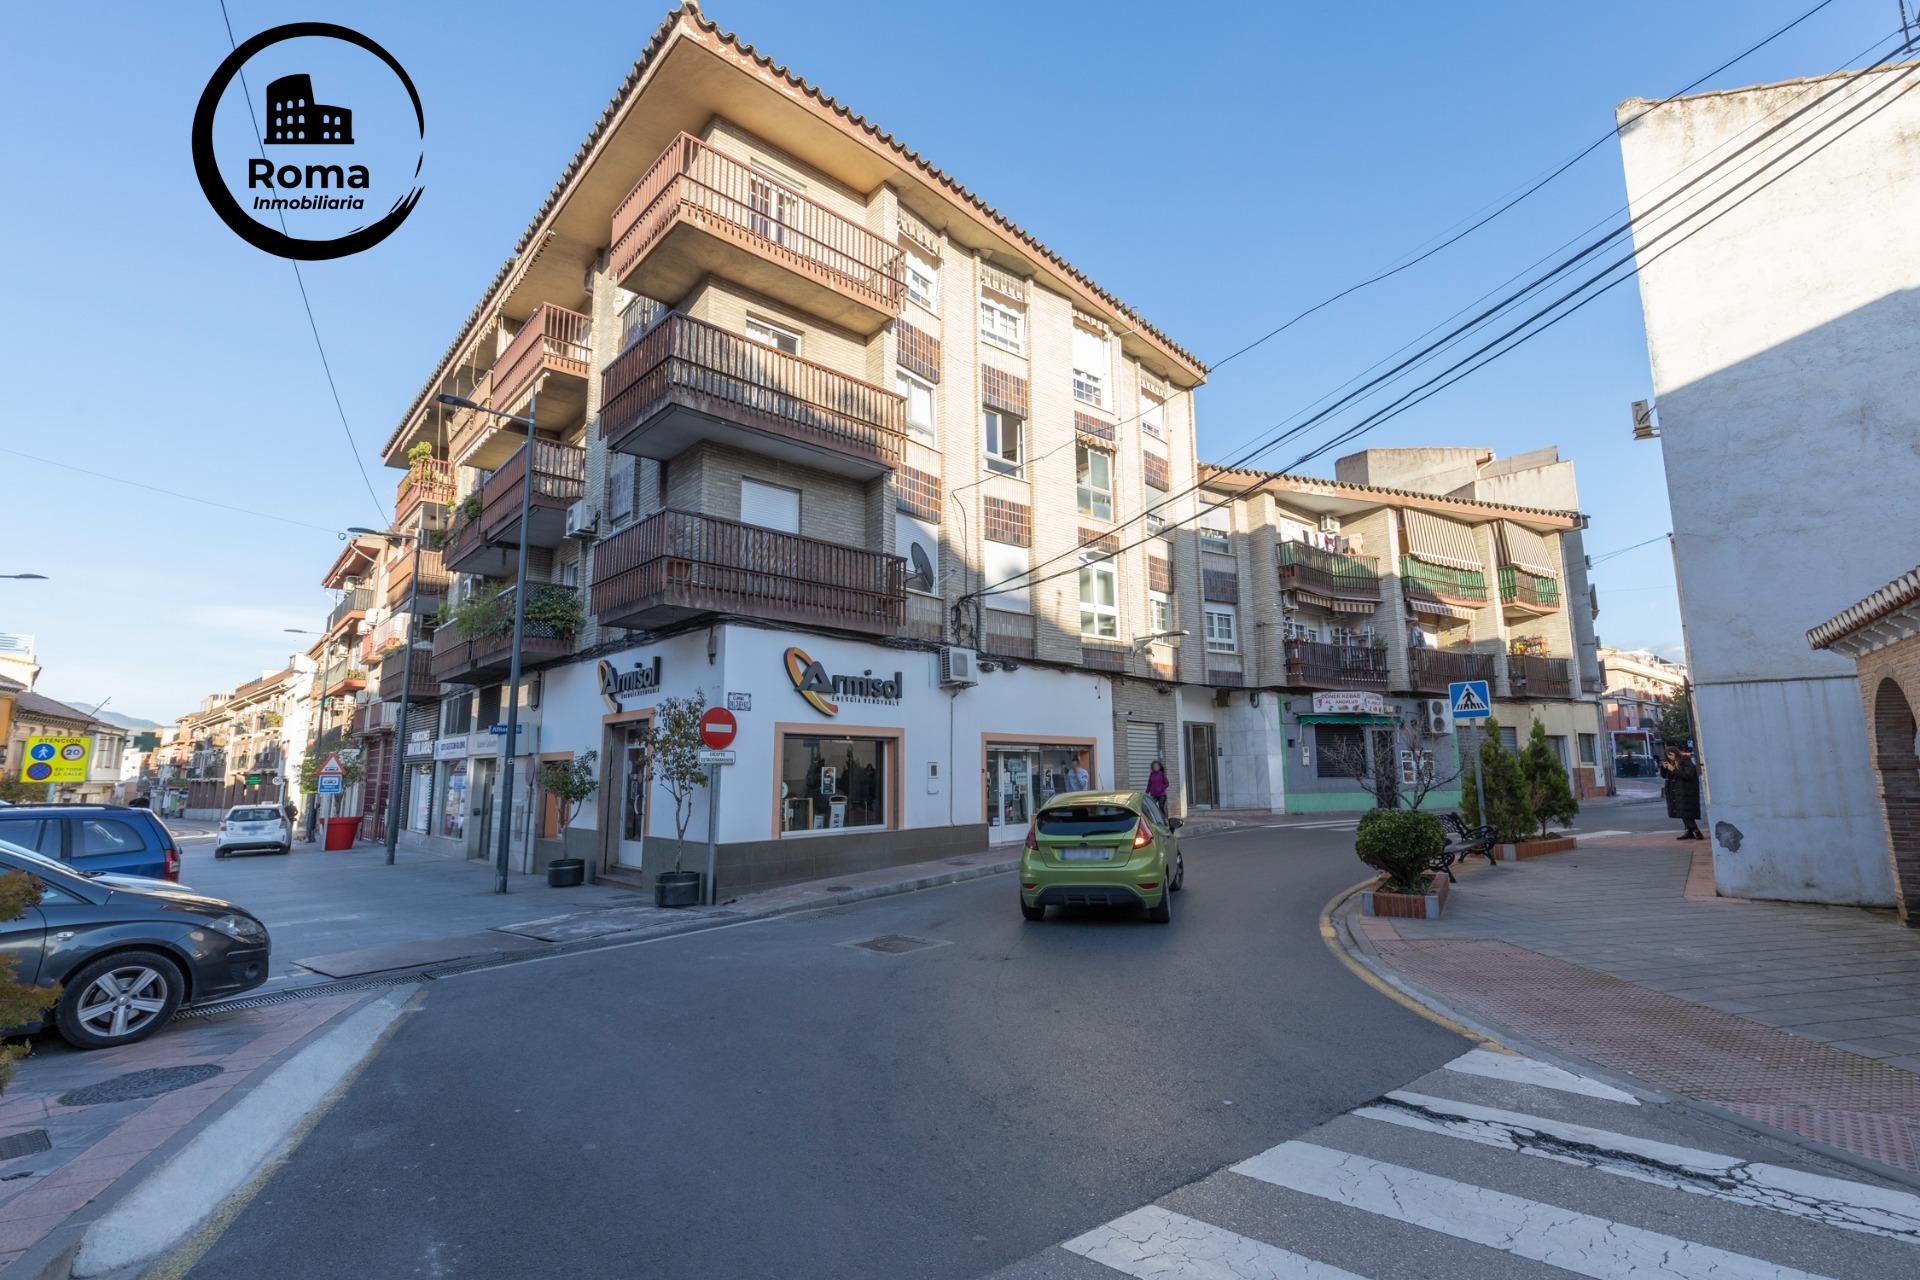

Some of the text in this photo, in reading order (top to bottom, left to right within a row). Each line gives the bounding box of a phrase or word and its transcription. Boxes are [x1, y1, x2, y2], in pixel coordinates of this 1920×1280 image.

[600, 656, 662, 695] Armisol
[795, 660, 903, 699] Armisol
[863, 697, 900, 707] RENOVABLE
